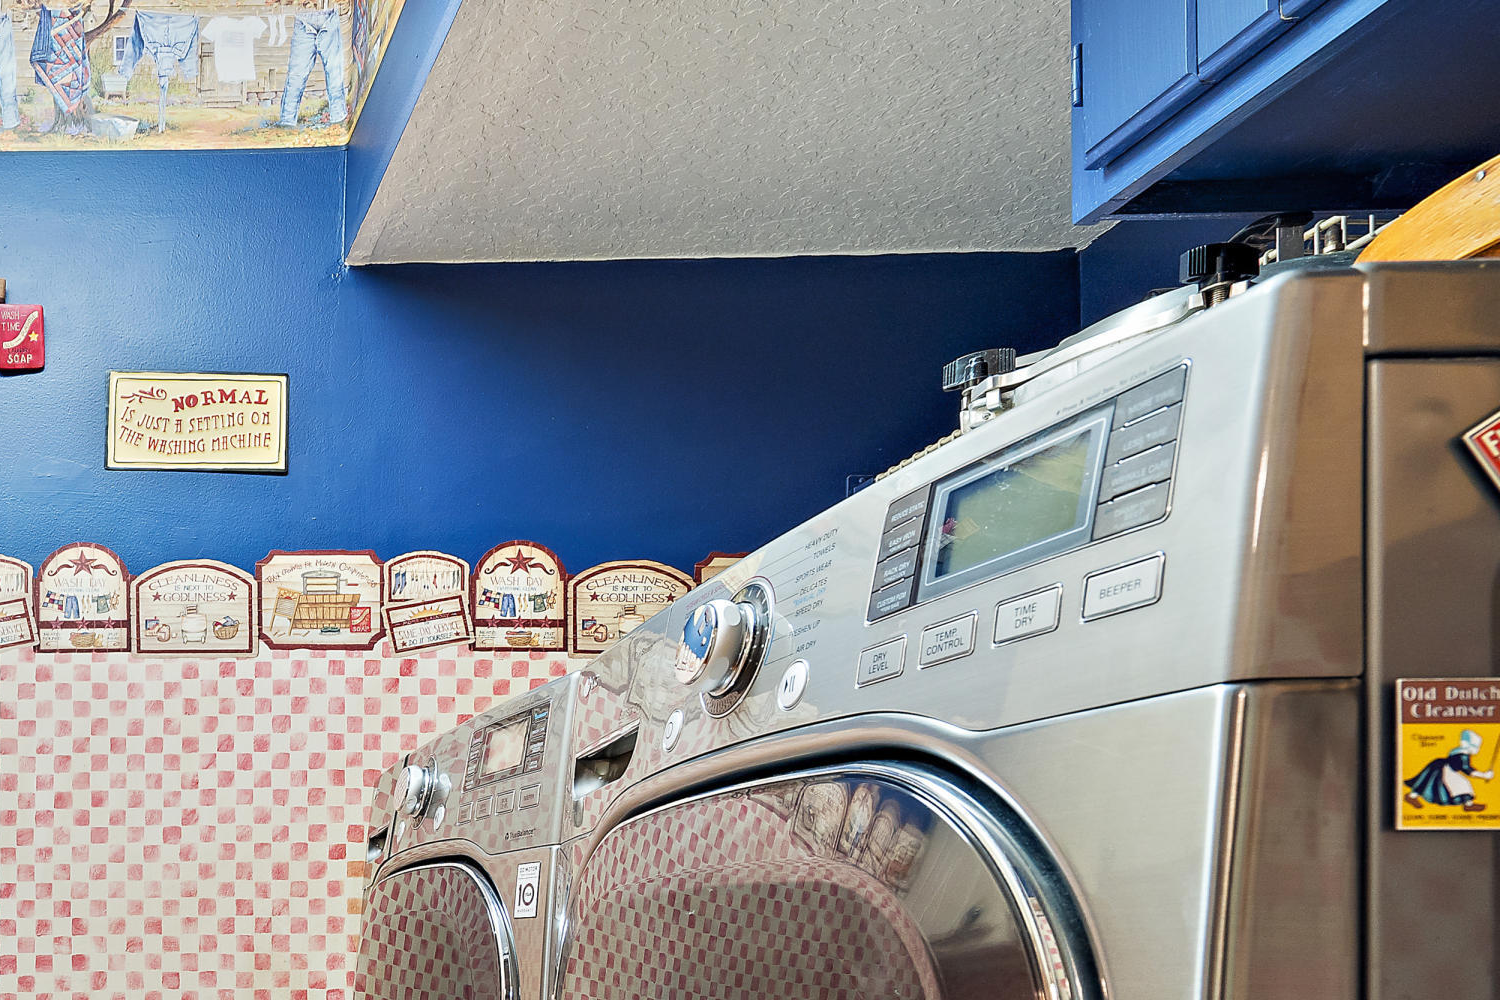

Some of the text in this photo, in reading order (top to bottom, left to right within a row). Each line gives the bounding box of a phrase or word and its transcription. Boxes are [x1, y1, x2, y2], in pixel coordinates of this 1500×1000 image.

[2, 322, 20, 332] TIME
[7, 354, 33, 364] SOAP
[171, 389, 269, 412] NORMAL
[120, 406, 270, 433] IS JUST A SETTING ON
[118, 426, 271, 455] THE WASHING MACHINE
[888, 536, 902, 548] EASY
[814, 542, 836, 560] TOWELS
[54, 578, 106, 587] WASH DAY
[148, 574, 239, 592] CLEANLINESS
[490, 576, 544, 586] WASH DAY
[586, 574, 680, 594] CLEANLINESS
[1100, 578, 1142, 600] BEEPER
[163, 592, 226, 602] GODLINESS
[600, 593, 666, 604] GODLINESS
[1014, 602, 1037, 617] TIME
[398, 628, 416, 640] SAME
[434, 620, 460, 633] SERVICE
[1014, 616, 1034, 629] DRY
[428, 632, 452, 642] YOURSELF
[926, 638, 964, 656] CONTROL
[873, 652, 887, 664] DRY
[868, 661, 888, 674] LEVEL
[1403, 686, 1500, 701] Old Dutch
[1410, 702, 1496, 718] Cleanser
[518, 882, 534, 906] 10
